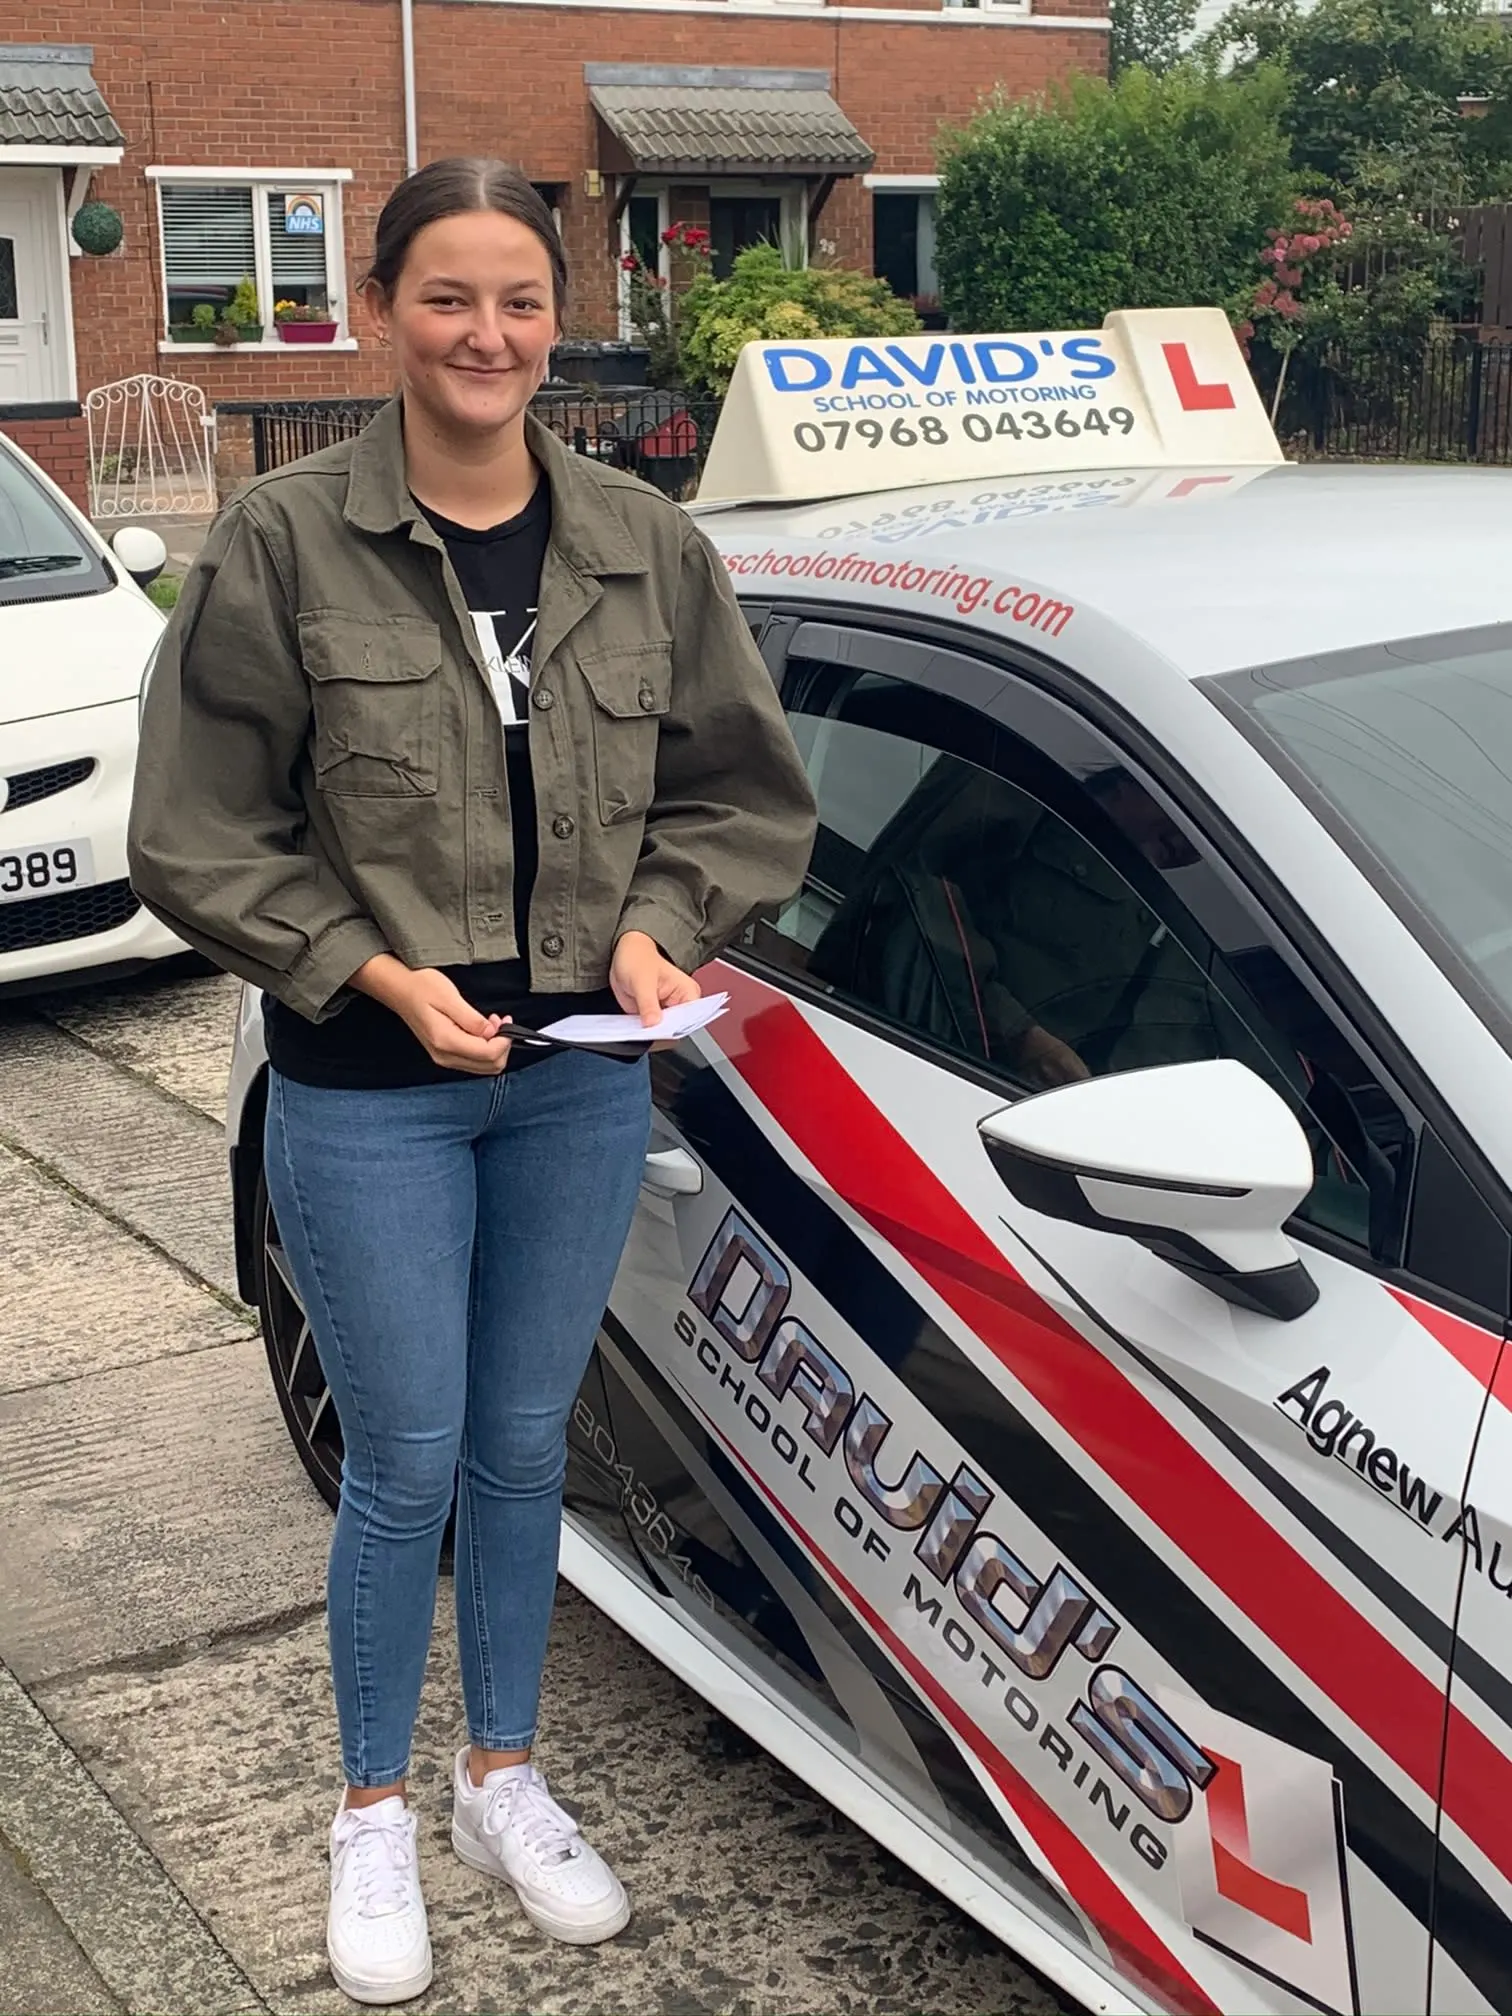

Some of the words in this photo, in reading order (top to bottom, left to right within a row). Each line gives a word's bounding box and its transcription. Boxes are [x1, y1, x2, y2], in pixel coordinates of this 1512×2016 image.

[289, 216, 320, 230] NHS
[762, 338, 1116, 392] DAVID'S
[1160, 342, 1236, 411] L
[813, 393, 921, 413] SCHOOL
[925, 391, 957, 407] OF
[966, 384, 1097, 406] MOTORING
[793, 416, 949, 452] 07968
[962, 406, 1135, 443] 043649
[720, 548, 1075, 638] schoolofmotoring.com
[0, 847, 77, 892] 389
[1276, 1365, 1443, 1527] Agnew
[673, 1310, 816, 1493] SCHOOL
[833, 1497, 892, 1563] OF
[902, 1573, 1169, 1871] MOTORING
